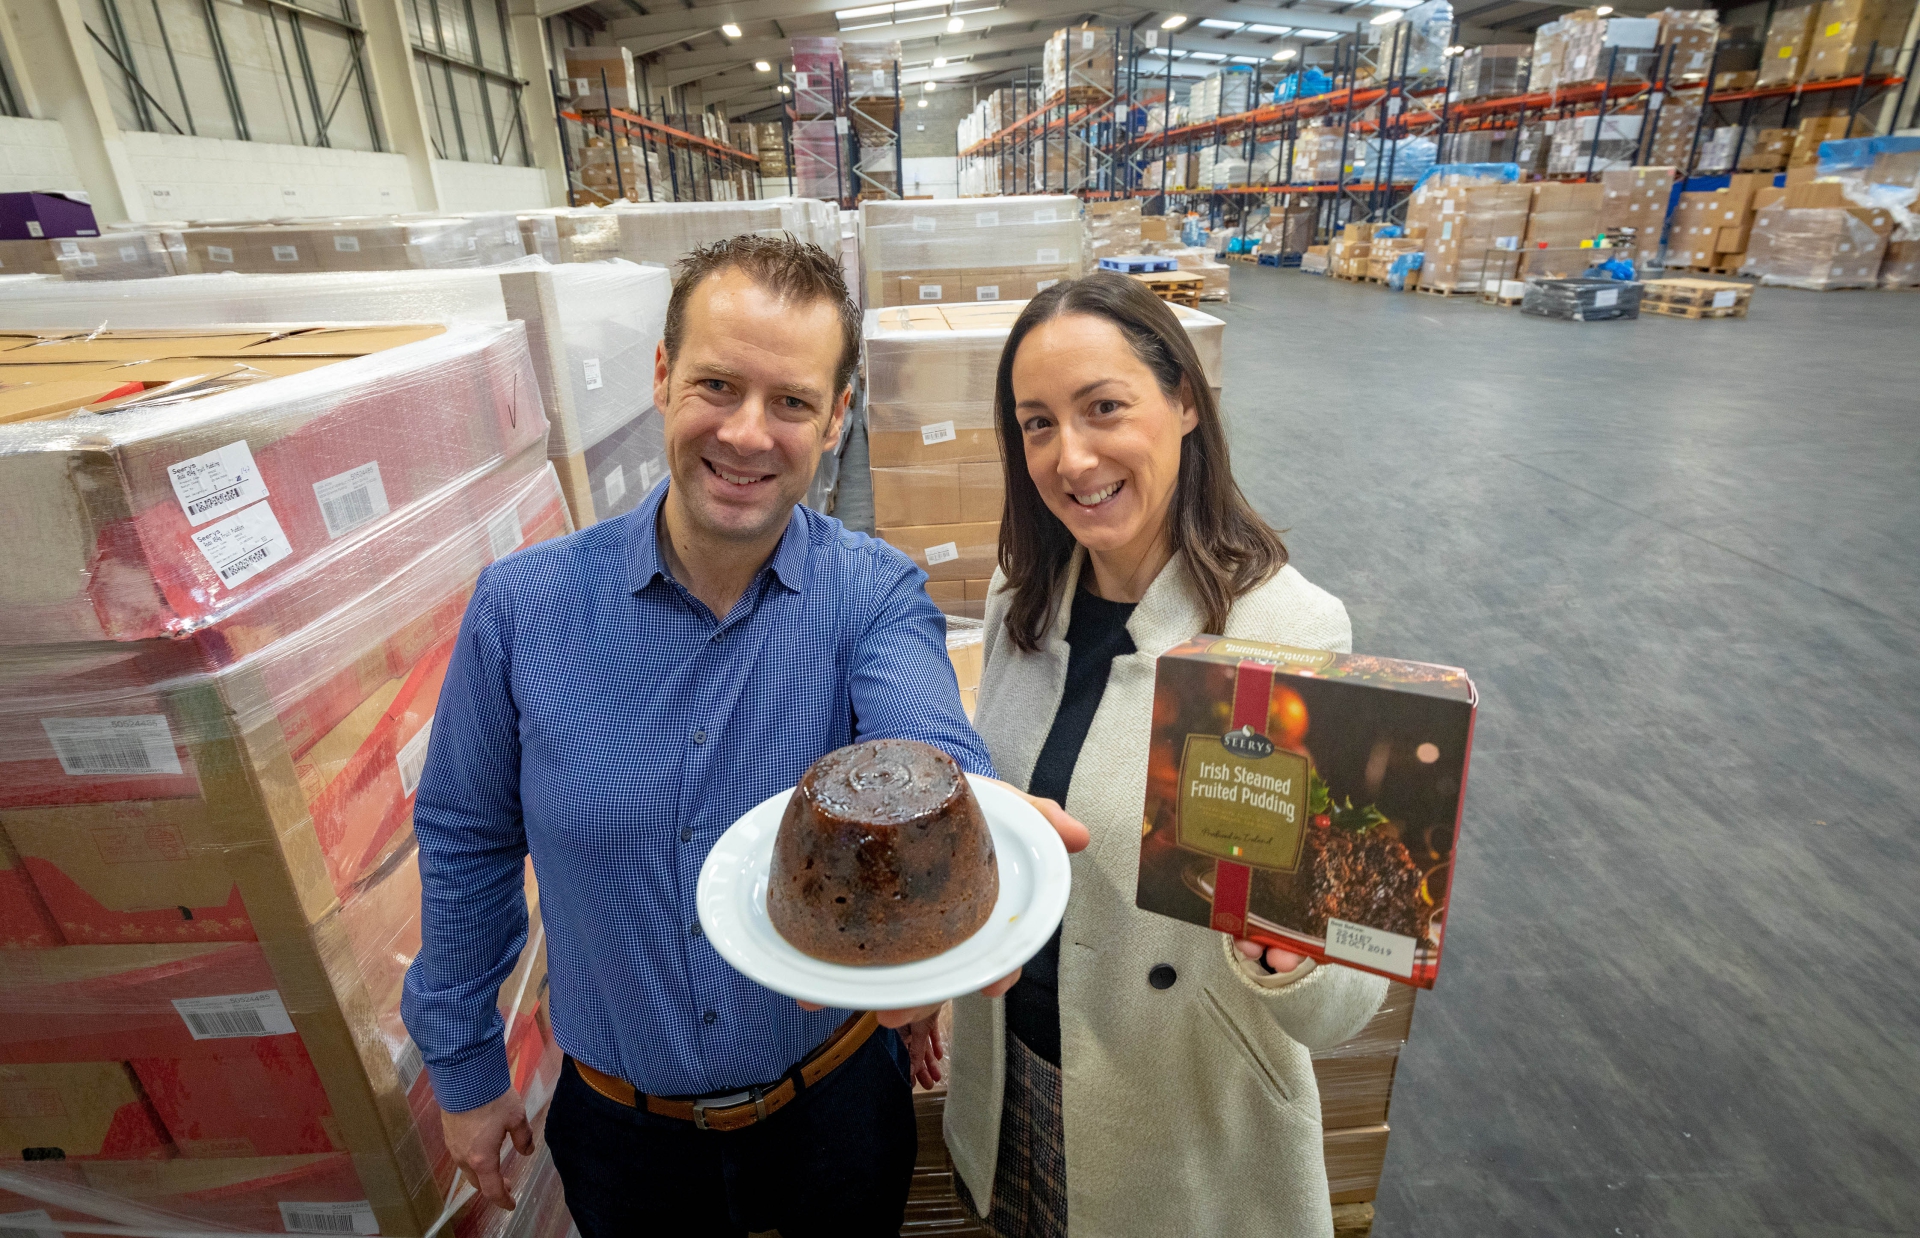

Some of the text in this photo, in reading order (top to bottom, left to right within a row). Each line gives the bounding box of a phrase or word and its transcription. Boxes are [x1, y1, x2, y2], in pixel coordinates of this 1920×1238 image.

[172, 463, 196, 475] Seerys
[197, 529, 221, 543] Seerys
[1224, 736, 1272, 754] SEERYS
[1199, 762, 1292, 796] Irish Steamed
[1191, 780, 1238, 802] Fruited
[1241, 787, 1295, 823] Pudding
[1348, 938, 1366, 951] OCT
[1367, 943, 1392, 956] 2019
[229, 994, 271, 1004] 50524485
